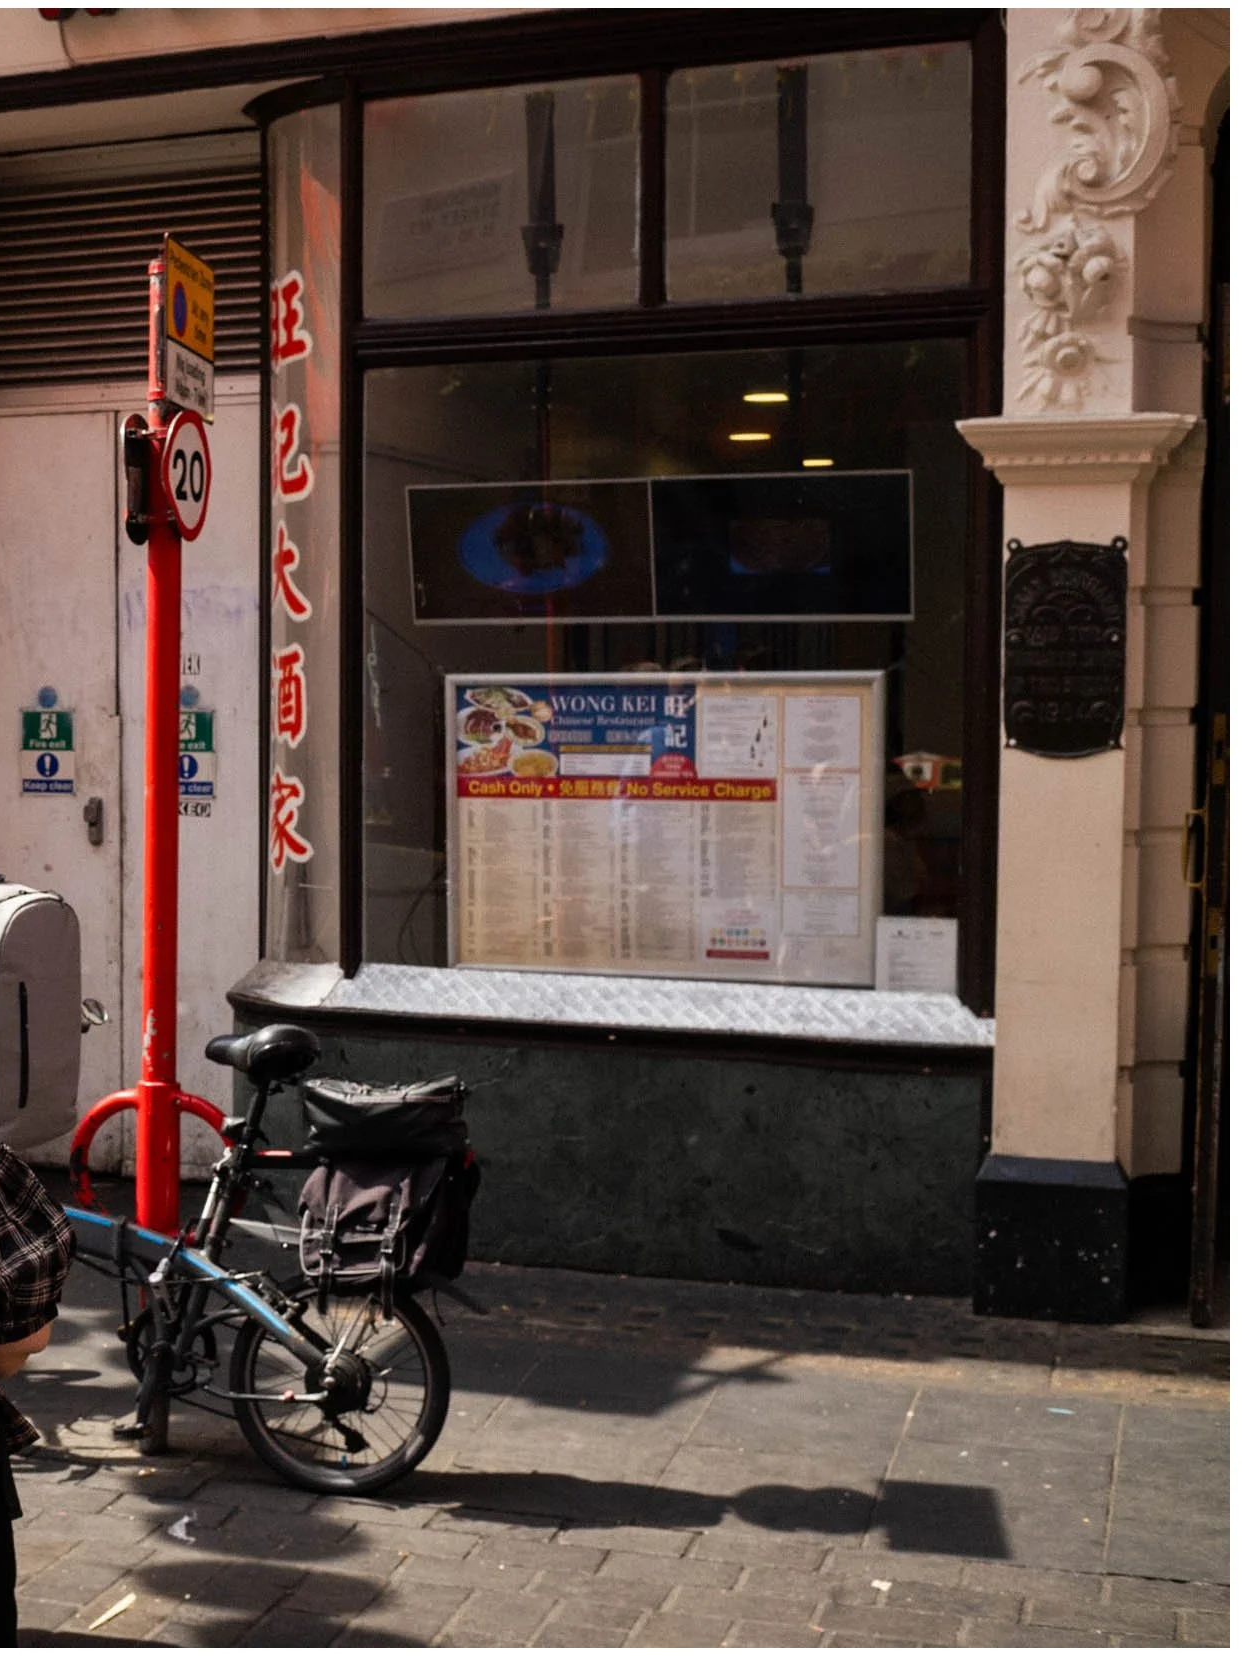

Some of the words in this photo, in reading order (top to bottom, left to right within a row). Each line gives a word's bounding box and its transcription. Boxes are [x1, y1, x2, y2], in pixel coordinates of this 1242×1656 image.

[173, 449, 204, 502] 20
[550, 695, 616, 713] WONG
[622, 695, 657, 713] KEI
[30, 739, 46, 749] Fire
[48, 739, 66, 749] exit
[187, 741, 206, 750] exit
[24, 780, 47, 793] Keep
[49, 780, 73, 792] clear
[187, 783, 213, 794] clear
[469, 780, 505, 794] Cash
[509, 780, 543, 797] Only
[626, 782, 648, 797] No
[652, 781, 710, 798] Service
[713, 782, 771, 800] Charge
